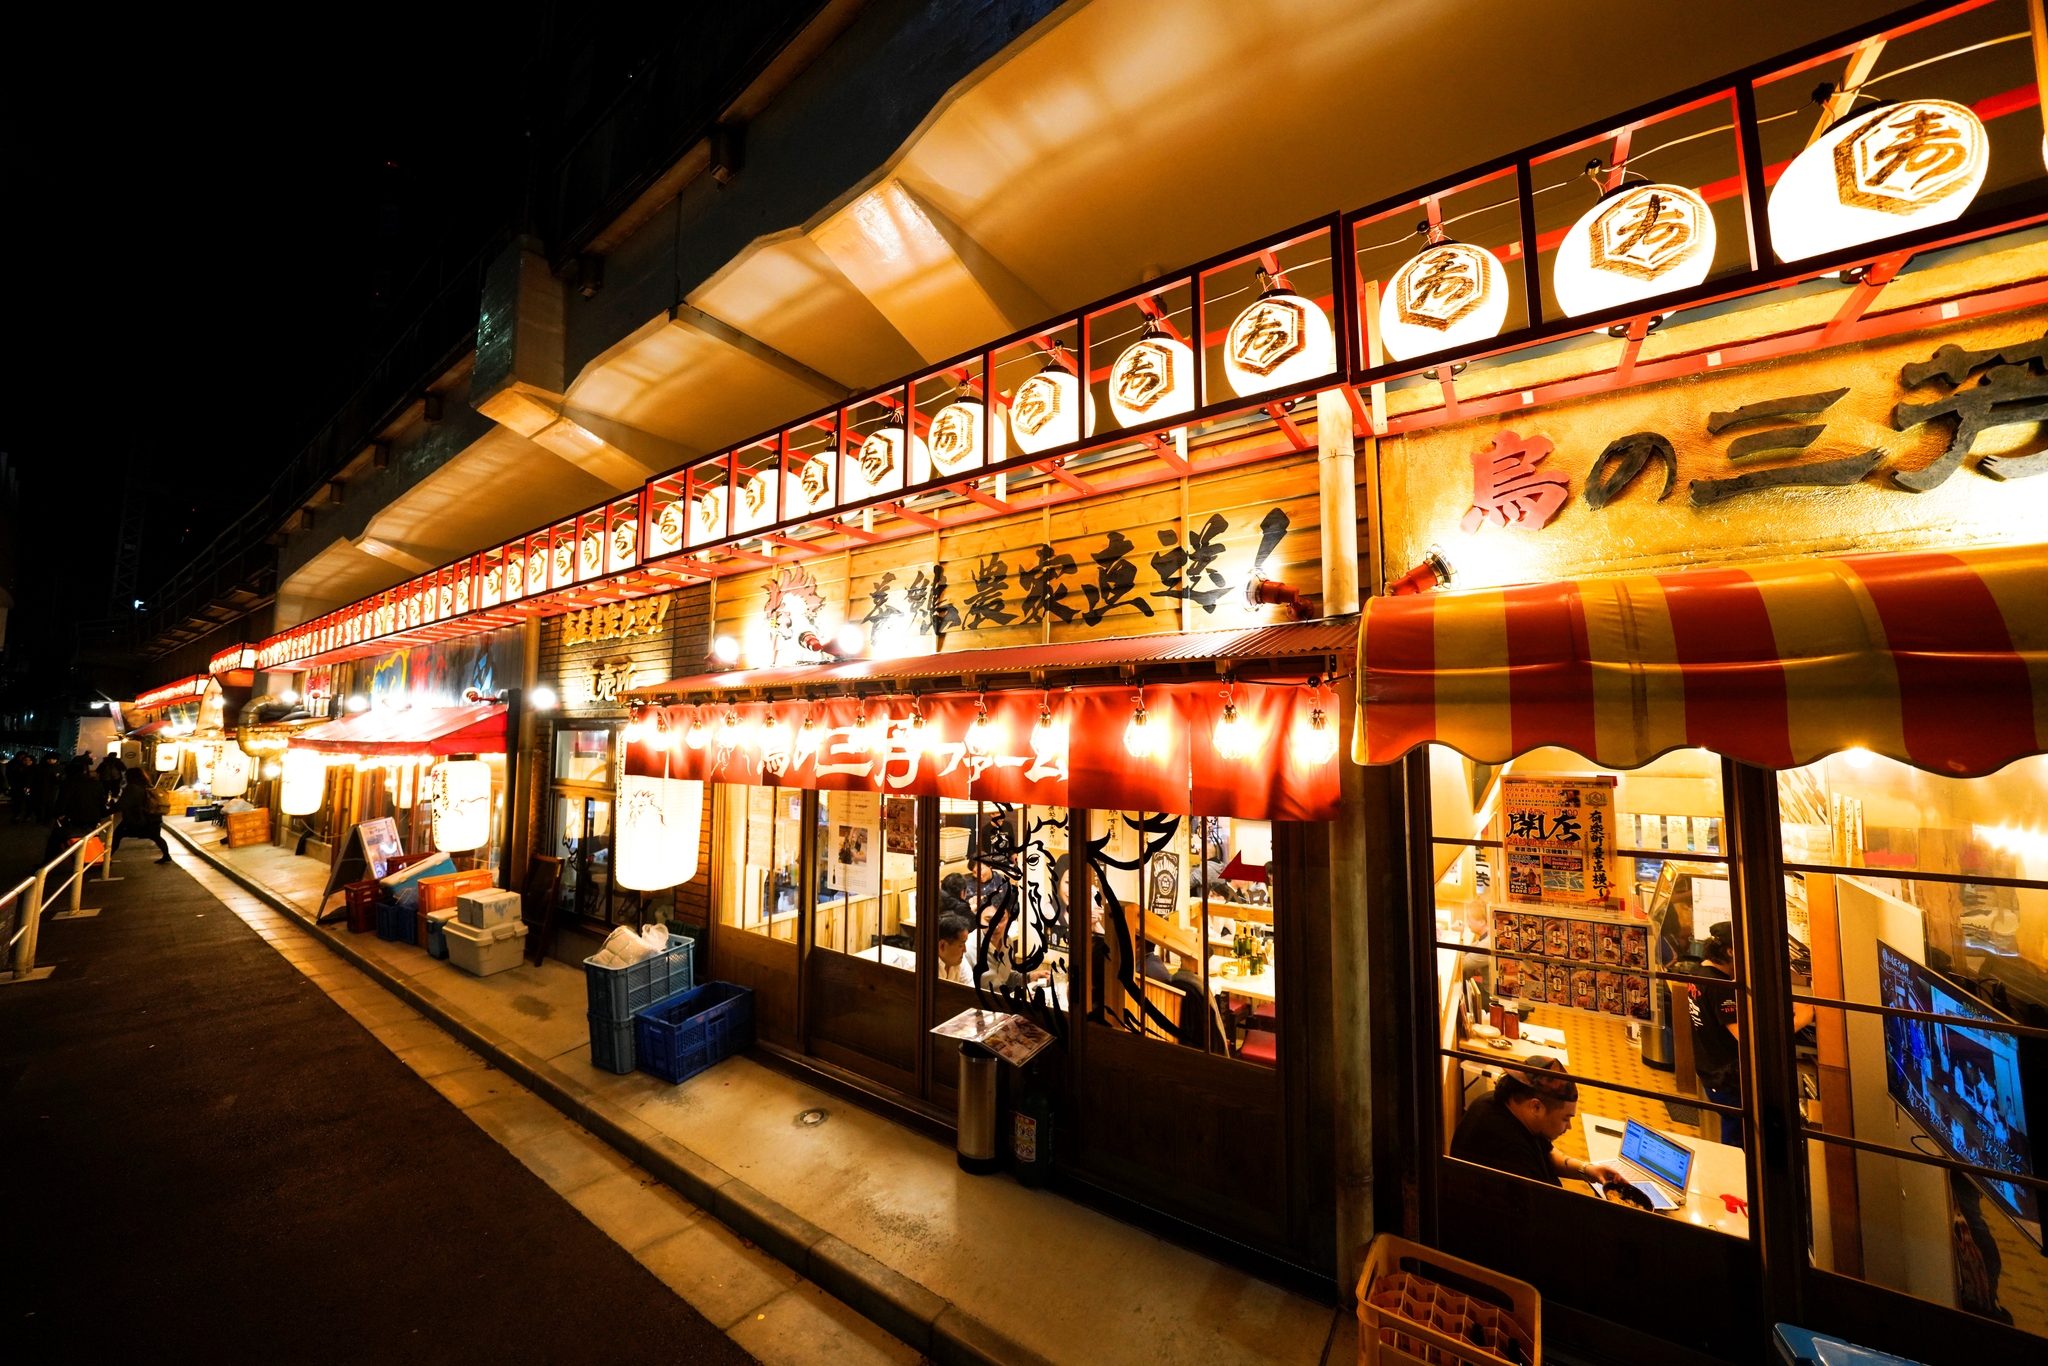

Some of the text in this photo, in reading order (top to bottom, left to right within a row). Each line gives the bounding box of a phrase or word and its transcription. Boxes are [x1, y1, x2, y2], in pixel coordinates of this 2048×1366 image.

[581, 662, 638, 702] 直売所
[1506, 810, 1582, 843] 開店
